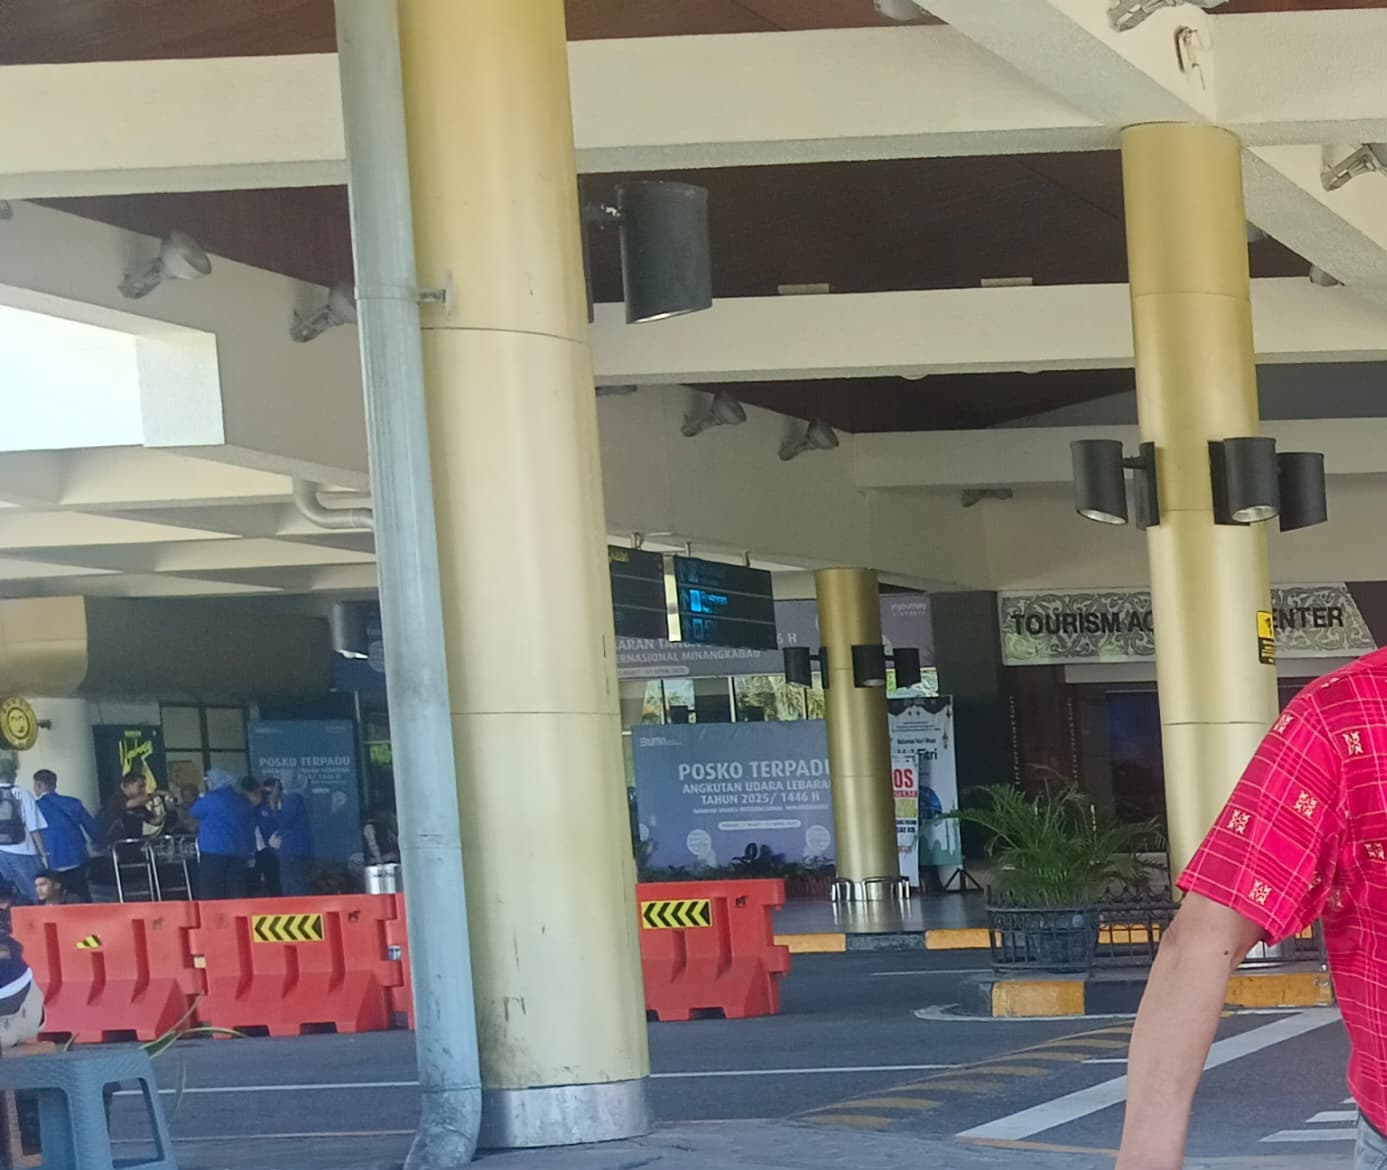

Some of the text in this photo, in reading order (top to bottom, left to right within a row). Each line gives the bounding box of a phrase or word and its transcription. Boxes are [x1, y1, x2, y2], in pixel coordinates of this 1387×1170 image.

[1011, 612, 1121, 635] TOURISM
[679, 762, 743, 780] POSKO
[682, 783, 742, 794] ANGKUTAN
[745, 781, 784, 792] UDARA
[701, 794, 738, 805] TAHUN
